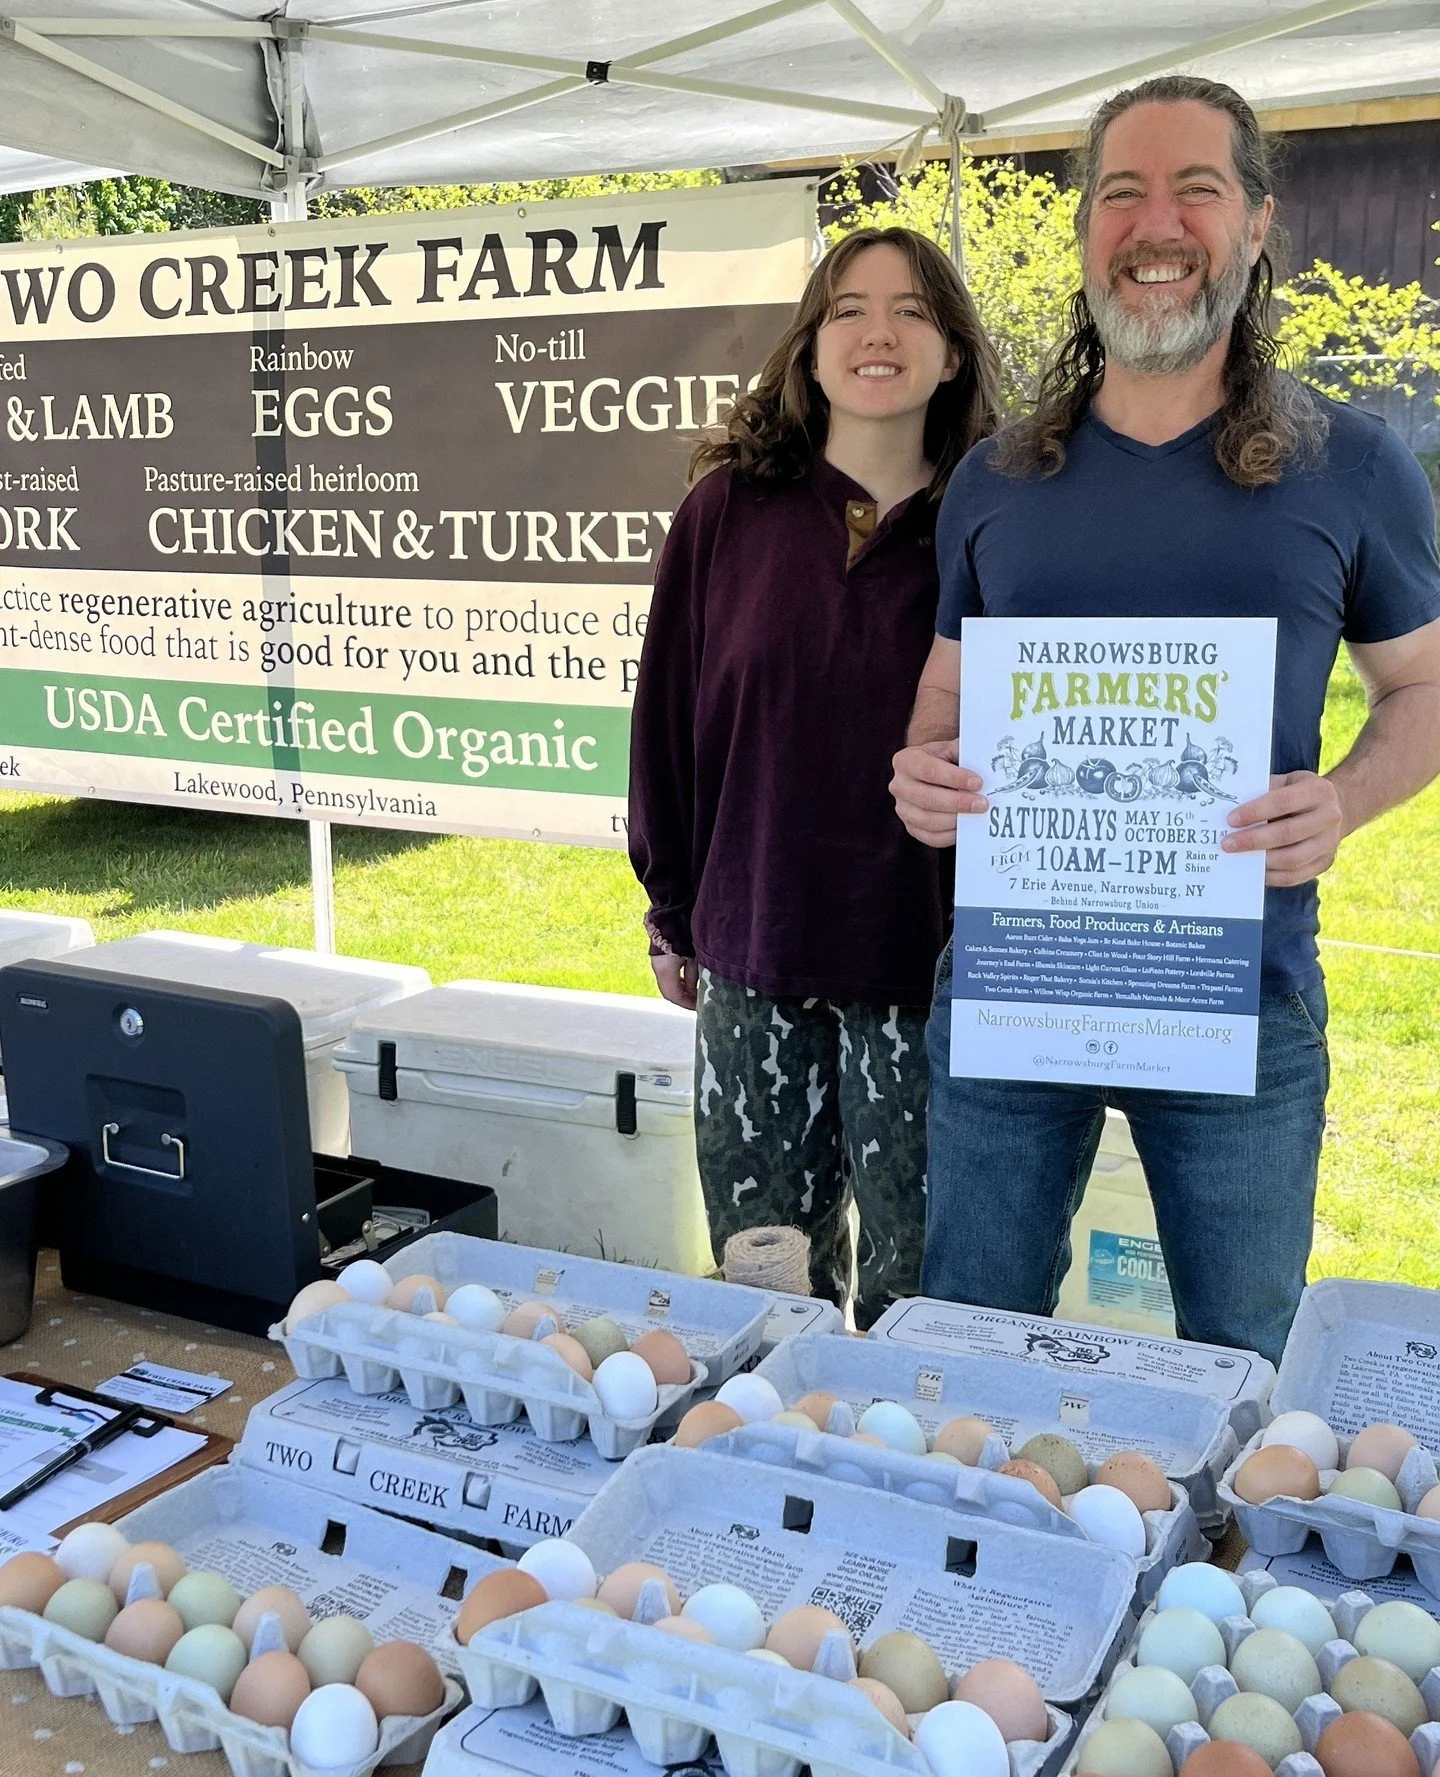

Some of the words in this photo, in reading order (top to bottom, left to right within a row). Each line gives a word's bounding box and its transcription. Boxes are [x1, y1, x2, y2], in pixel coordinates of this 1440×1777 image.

[0, 262, 116, 325] WO
[139, 242, 392, 319] CREEK
[416, 220, 668, 304] FARM
[249, 342, 354, 373] Rainbow
[494, 328, 586, 364] No-till
[41, 392, 175, 441] LAMB
[250, 385, 394, 438] EGGS
[494, 373, 763, 434] VEGGIE
[144, 464, 303, 493] Pasture-raised
[309, 464, 420, 493] heirloom
[148, 507, 385, 559] CHICKEN
[0, 583, 52, 613] ctice
[58, 587, 232, 624] regenerative
[242, 592, 412, 632] agriculture
[422, 602, 454, 631] to
[465, 597, 600, 642] produce
[100, 623, 156, 658] food
[165, 626, 219, 662] that
[228, 632, 250, 663] is
[259, 633, 333, 673] good
[343, 634, 389, 671] for
[399, 648, 460, 682] you
[471, 643, 536, 679] and
[547, 644, 607, 682] the
[1017, 641, 1219, 666] NARROWSBURG
[1009, 669, 1230, 725] FARMERS'
[43, 684, 169, 739] USDA
[178, 695, 379, 757] Certified
[392, 709, 600, 779] Organic
[1051, 715, 1180, 748] MARKET
[173, 771, 284, 806] Lakewood,
[291, 781, 438, 818] Pennsylvania
[988, 804, 1118, 842] SATURDAYS
[1124, 810, 1161, 827] MAY
[1124, 827, 1197, 844] OCTOBER
[990, 851, 1031, 868] FROM
[1184, 862, 1211, 873] Shine
[1185, 851, 1207, 861] Rain
[1208, 852, 1220, 861] or
[1008, 877, 1018, 890] 7
[1021, 877, 1047, 891] Erie
[1050, 878, 1098, 894] Avenue,
[1100, 880, 1182, 899] Narrowsburg,
[1185, 884, 1206, 897] NY
[1050, 896, 1078, 907] Behind
[1081, 897, 1133, 911] Narrowsburg
[1135, 899, 1160, 910] Union
[991, 911, 1046, 929] Farmers,
[1049, 914, 1081, 930] Food
[1084, 915, 1149, 933] Producers
[1153, 919, 1166, 933] &
[1168, 919, 1224, 937] Artisans
[1008, 946, 1028, 956] Bakery
[1055, 949, 1084, 959] Creamery
[1110, 951, 1128, 959] Wood
[1132, 952, 1146, 960] Four
[1146, 953, 1162, 962] Story
[1223, 957, 1250, 968] Catering
[1141, 939, 1160, 947] House
[1165, 940, 1187, 948] Botanic
[1188, 941, 1206, 949] Bakes
[1053, 975, 1073, 985] Bakery
[1101, 977, 1124, 986] Kitchen
[1128, 979, 1157, 990] Sprouting
[1180, 982, 1197, 990] Farm
[1224, 984, 1243, 993] Farms
[1056, 961, 1081, 970] Skincare
[1085, 963, 1100, 973] Light
[1164, 968, 1185, 978] Pottery
[1216, 970, 1235, 979] Farms
[983, 985, 996, 993] Two
[996, 985, 1014, 994] Creek
[1014, 986, 1029, 995] Farm
[1070, 989, 1093, 999] Organic
[1093, 991, 1109, 999] Farm
[1208, 997, 1225, 1006] Farm
[977, 1008, 1233, 1044] NarrowsburgFarmersMarket.org
[1032, 1054, 1172, 1074] @NarrowsburgFarmMarket
[1118, 1237, 1162, 1253] ENGE
[1117, 1255, 1169, 1284] COOLE
[972, 1313, 1048, 1333] ORGANIC
[1052, 1327, 1134, 1346] RAINBOW
[1136, 1340, 1185, 1357] EGGS
[1366, 1350, 1393, 1361] About
[1395, 1355, 1414, 1365] Two
[264, 1441, 314, 1472] TWO
[368, 1468, 451, 1509] CREEK
[501, 1502, 576, 1539] FARM
[989, 1588, 1053, 1609] Regenerative
